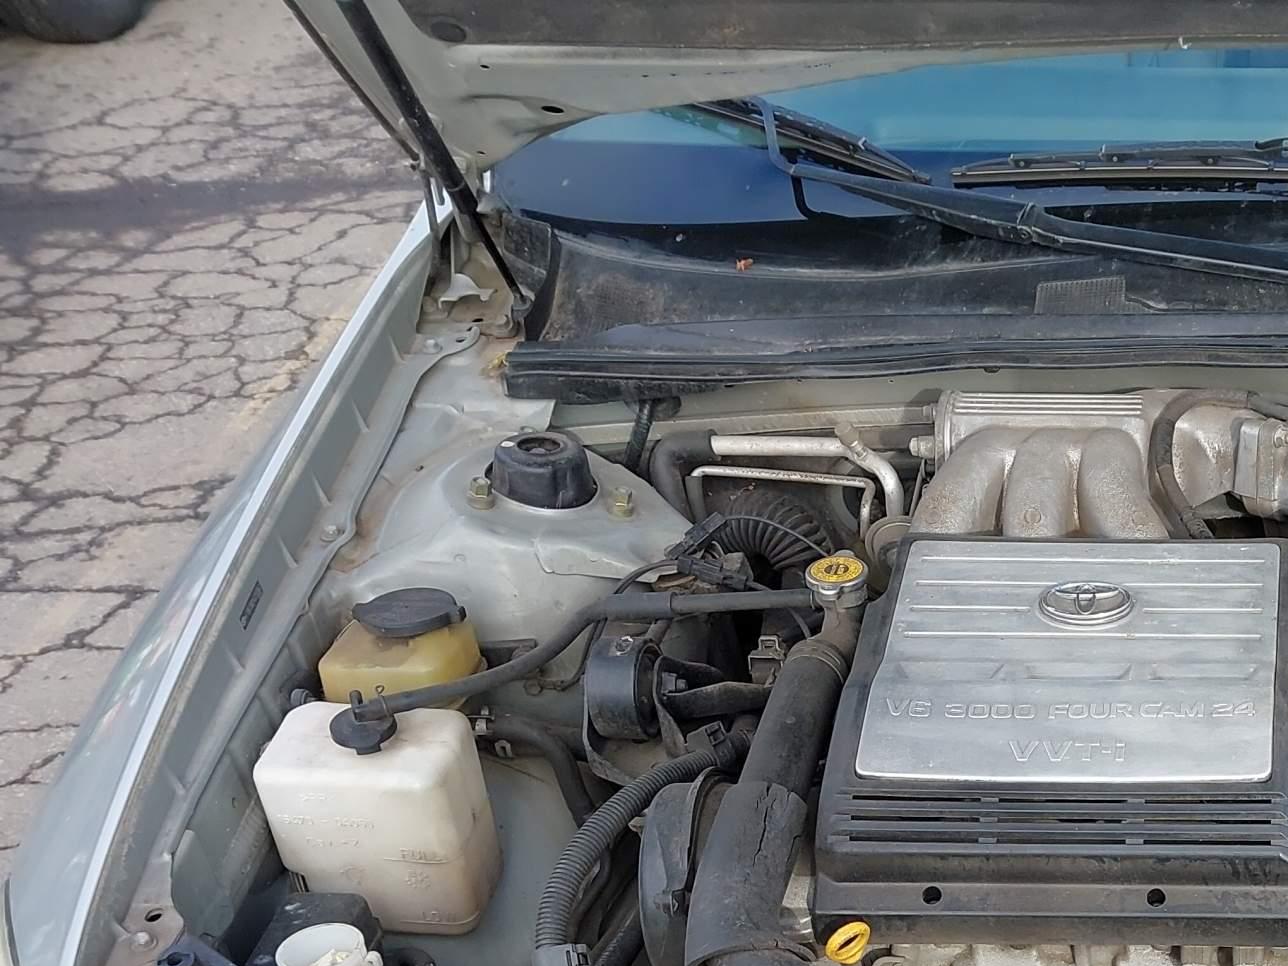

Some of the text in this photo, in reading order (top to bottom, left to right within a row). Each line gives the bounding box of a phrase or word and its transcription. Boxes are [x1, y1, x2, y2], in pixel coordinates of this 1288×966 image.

[886, 698, 1256, 719] V6 3000 FOUR CAM 24
[1008, 740, 1126, 762] VVT-i
